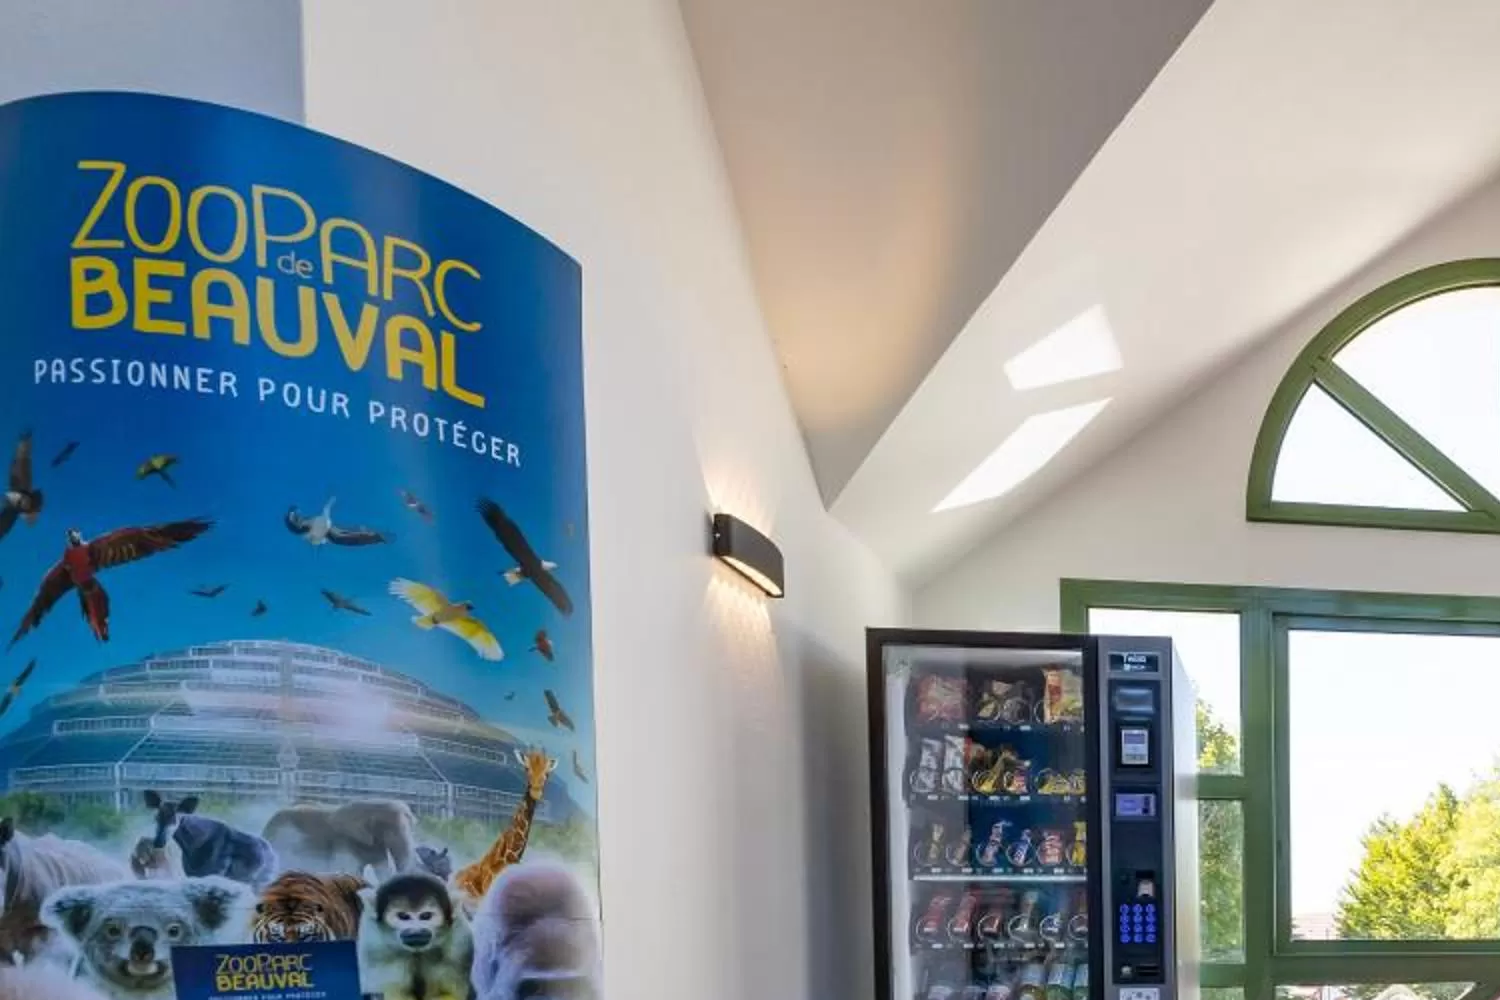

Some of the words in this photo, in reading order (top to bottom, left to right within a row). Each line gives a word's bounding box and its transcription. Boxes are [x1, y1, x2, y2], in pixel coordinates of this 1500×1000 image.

[70, 160, 482, 332] ZOOPARC
[277, 251, 314, 279] de
[70, 255, 486, 408] BEAUVAL
[34, 357, 239, 399] PASSIONNER
[258, 377, 350, 419] POUR
[369, 399, 522, 468] PROTÉGER
[215, 953, 314, 975] ZOOPARC
[215, 971, 317, 992] BEAUVAL
